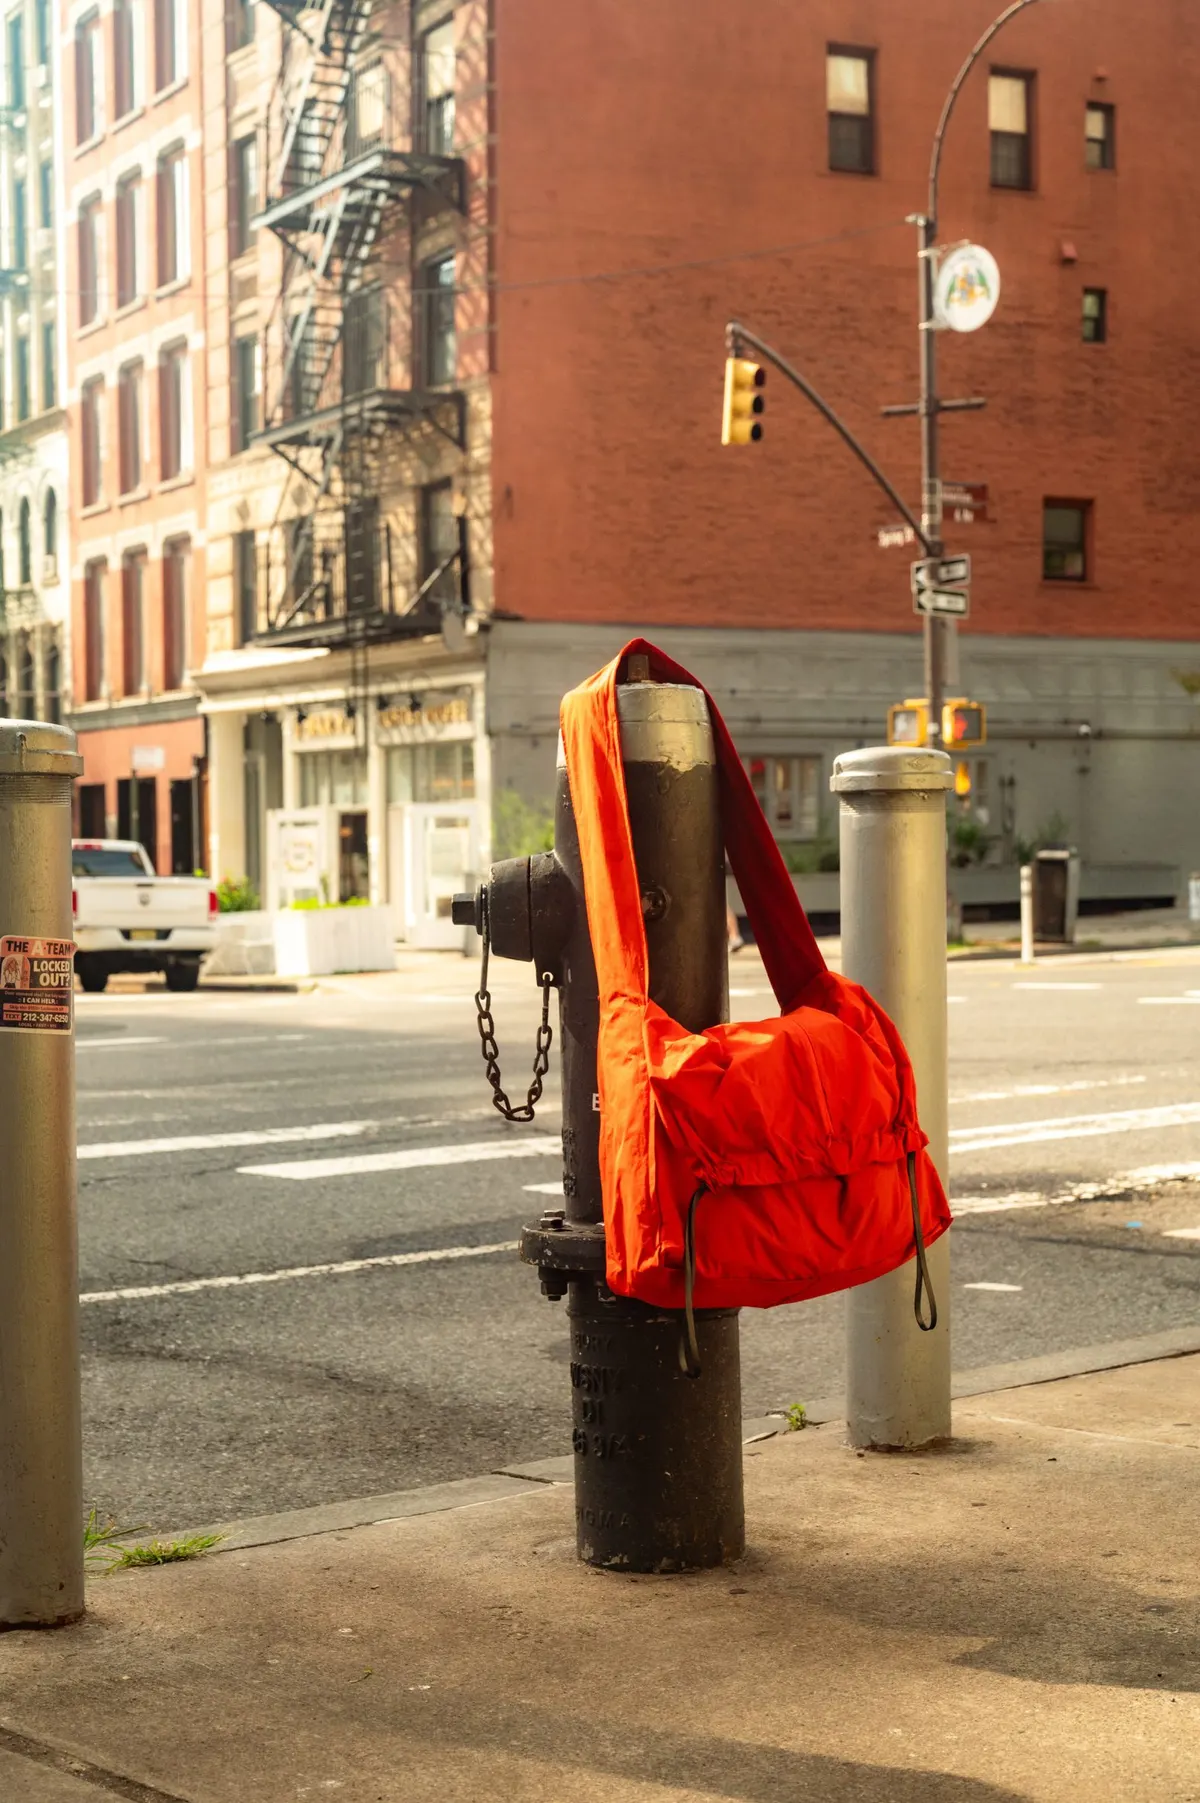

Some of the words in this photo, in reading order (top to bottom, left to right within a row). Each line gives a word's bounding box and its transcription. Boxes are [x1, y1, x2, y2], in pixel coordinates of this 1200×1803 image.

[6, 940, 29, 953] THE
[33, 960, 70, 973] LOCKED
[39, 972, 70, 987] OUT?
[5, 1012, 21, 1020] TEXT
[22, 1013, 69, 1023] 212-347-6250
